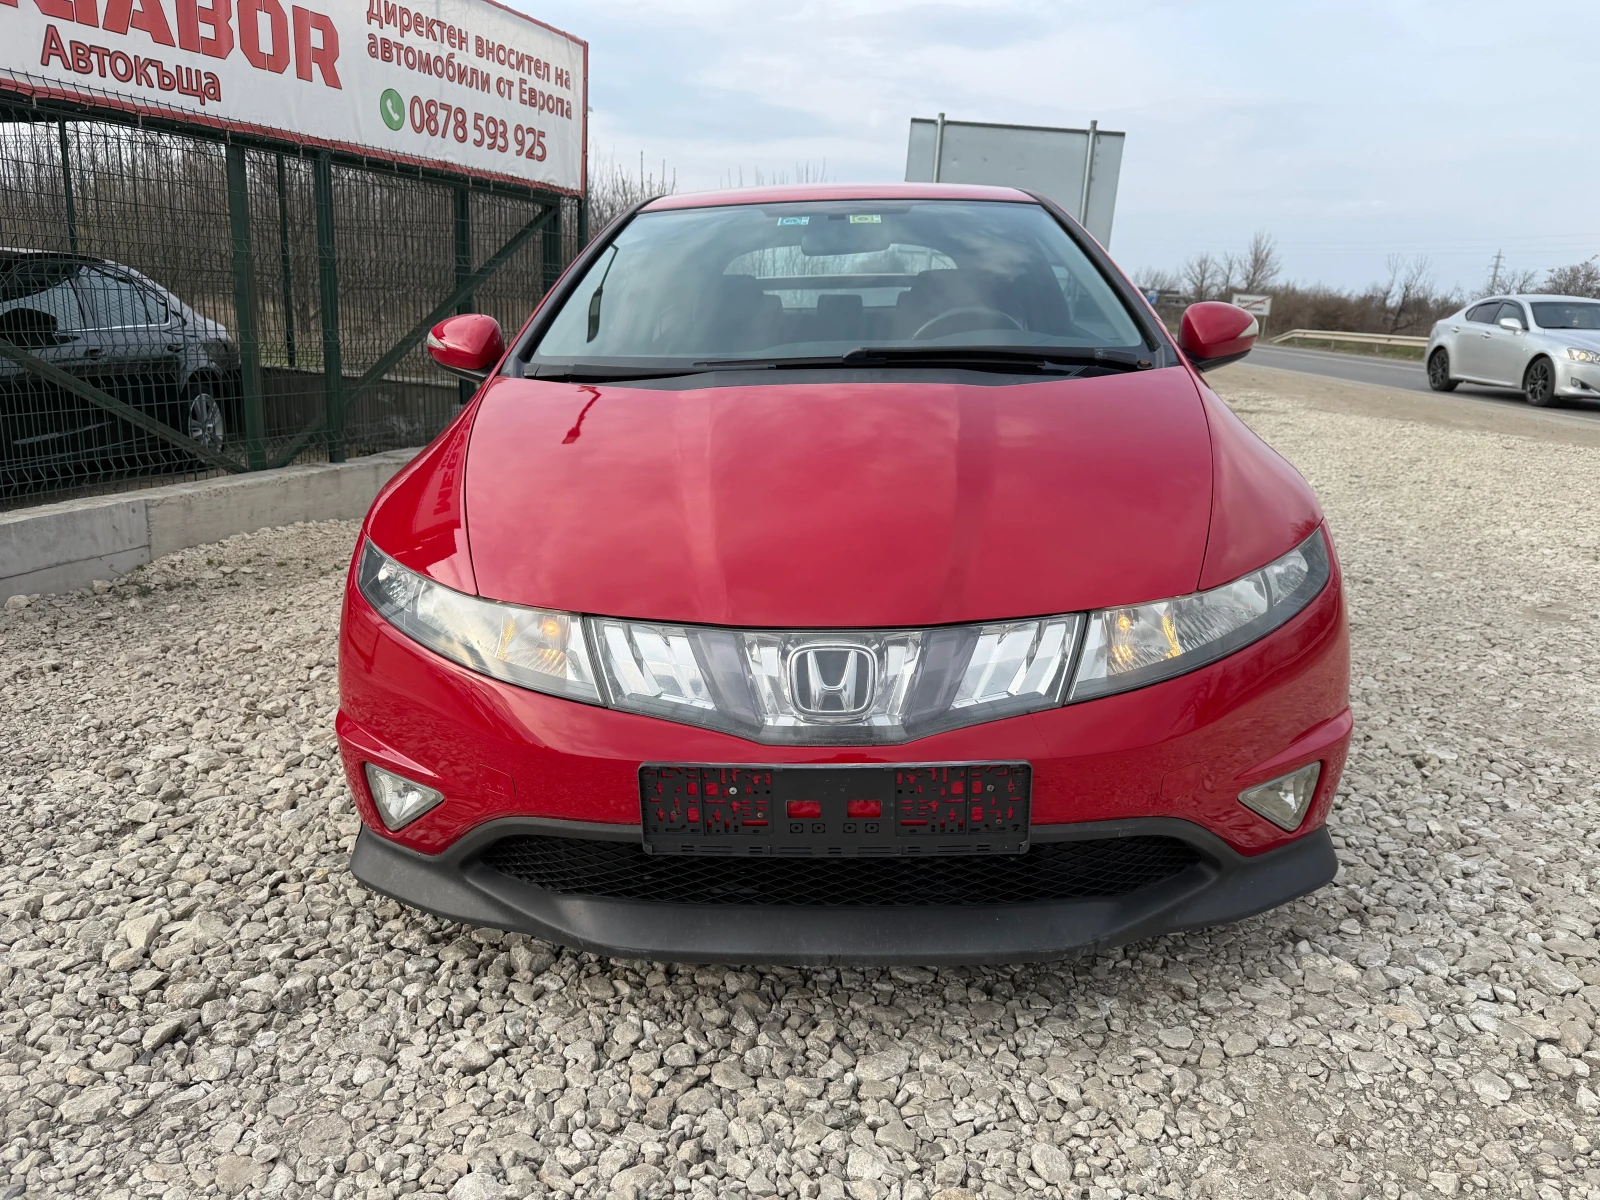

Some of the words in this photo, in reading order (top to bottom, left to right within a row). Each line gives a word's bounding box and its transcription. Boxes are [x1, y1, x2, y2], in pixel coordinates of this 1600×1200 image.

[41, 24, 221, 105] Автокъща
[367, 0, 469, 52] Директен
[475, 36, 550, 82] вносител
[555, 67, 571, 90] на
[367, 33, 491, 94] автомобили
[496, 77, 514, 100] от
[519, 78, 572, 120] Европа
[409, 95, 468, 143] 0878
[473, 112, 509, 153] 593
[514, 124, 547, 162] 925
